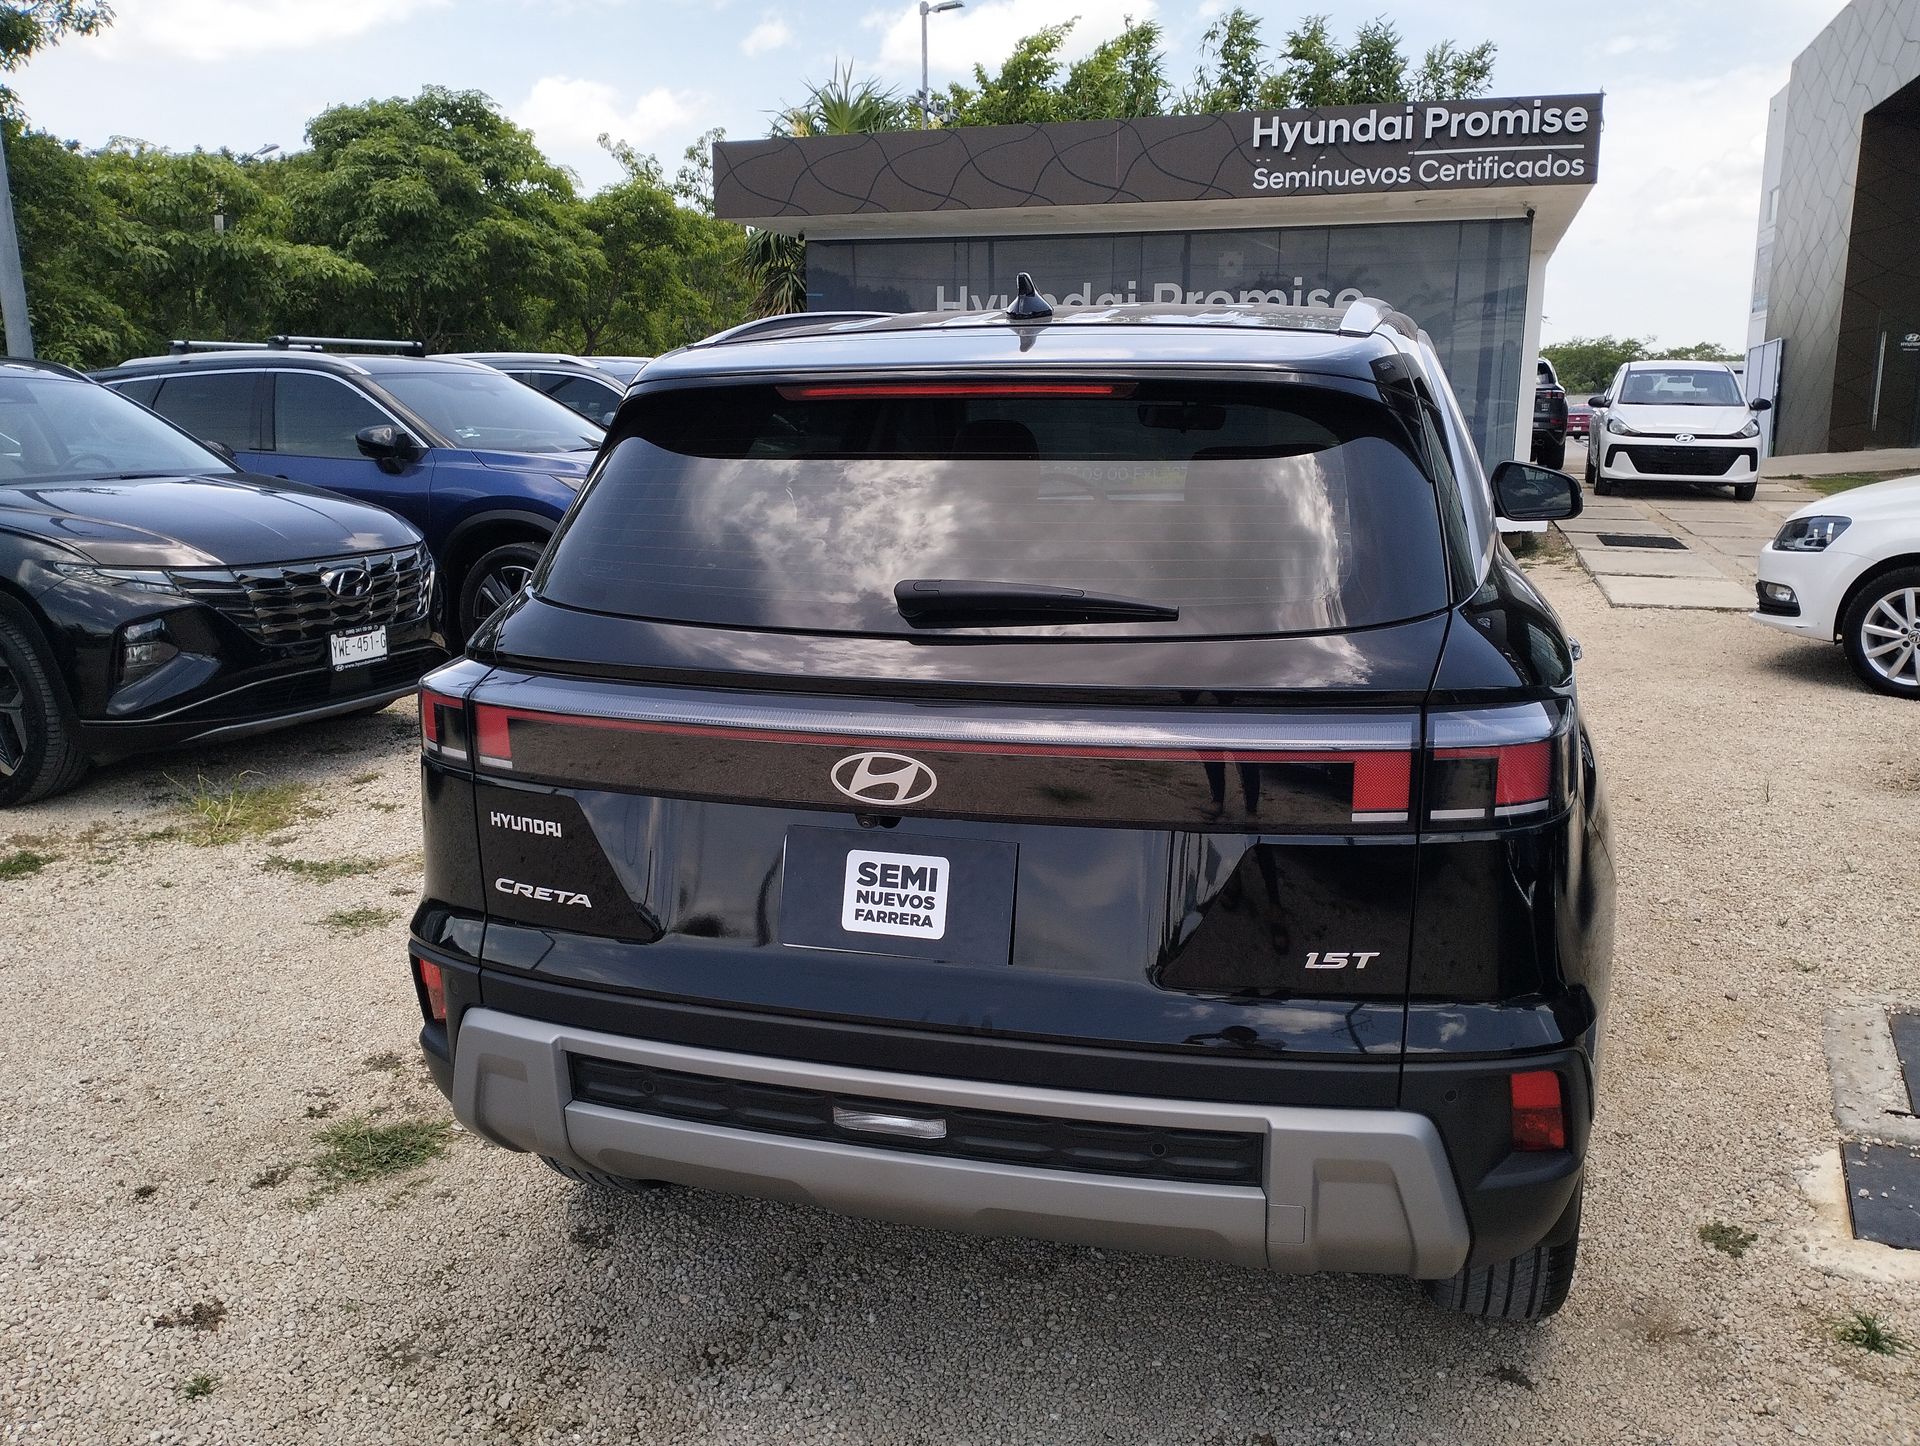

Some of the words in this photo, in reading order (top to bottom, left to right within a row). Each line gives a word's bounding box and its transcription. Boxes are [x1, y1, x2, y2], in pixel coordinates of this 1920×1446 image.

[1252, 105, 1413, 153] Hyundai
[1424, 100, 1589, 139] Promise
[1252, 163, 1411, 190] Seminuevos
[1418, 153, 1585, 180] Certificados
[935, 281, 1136, 312] Hydai
[490, 811, 562, 838] HYUNDAI
[495, 877, 593, 908] CRETA
[856, 861, 939, 893] SEMI
[855, 889, 936, 911] NUEVOS
[854, 908, 934, 928] FARRERA
